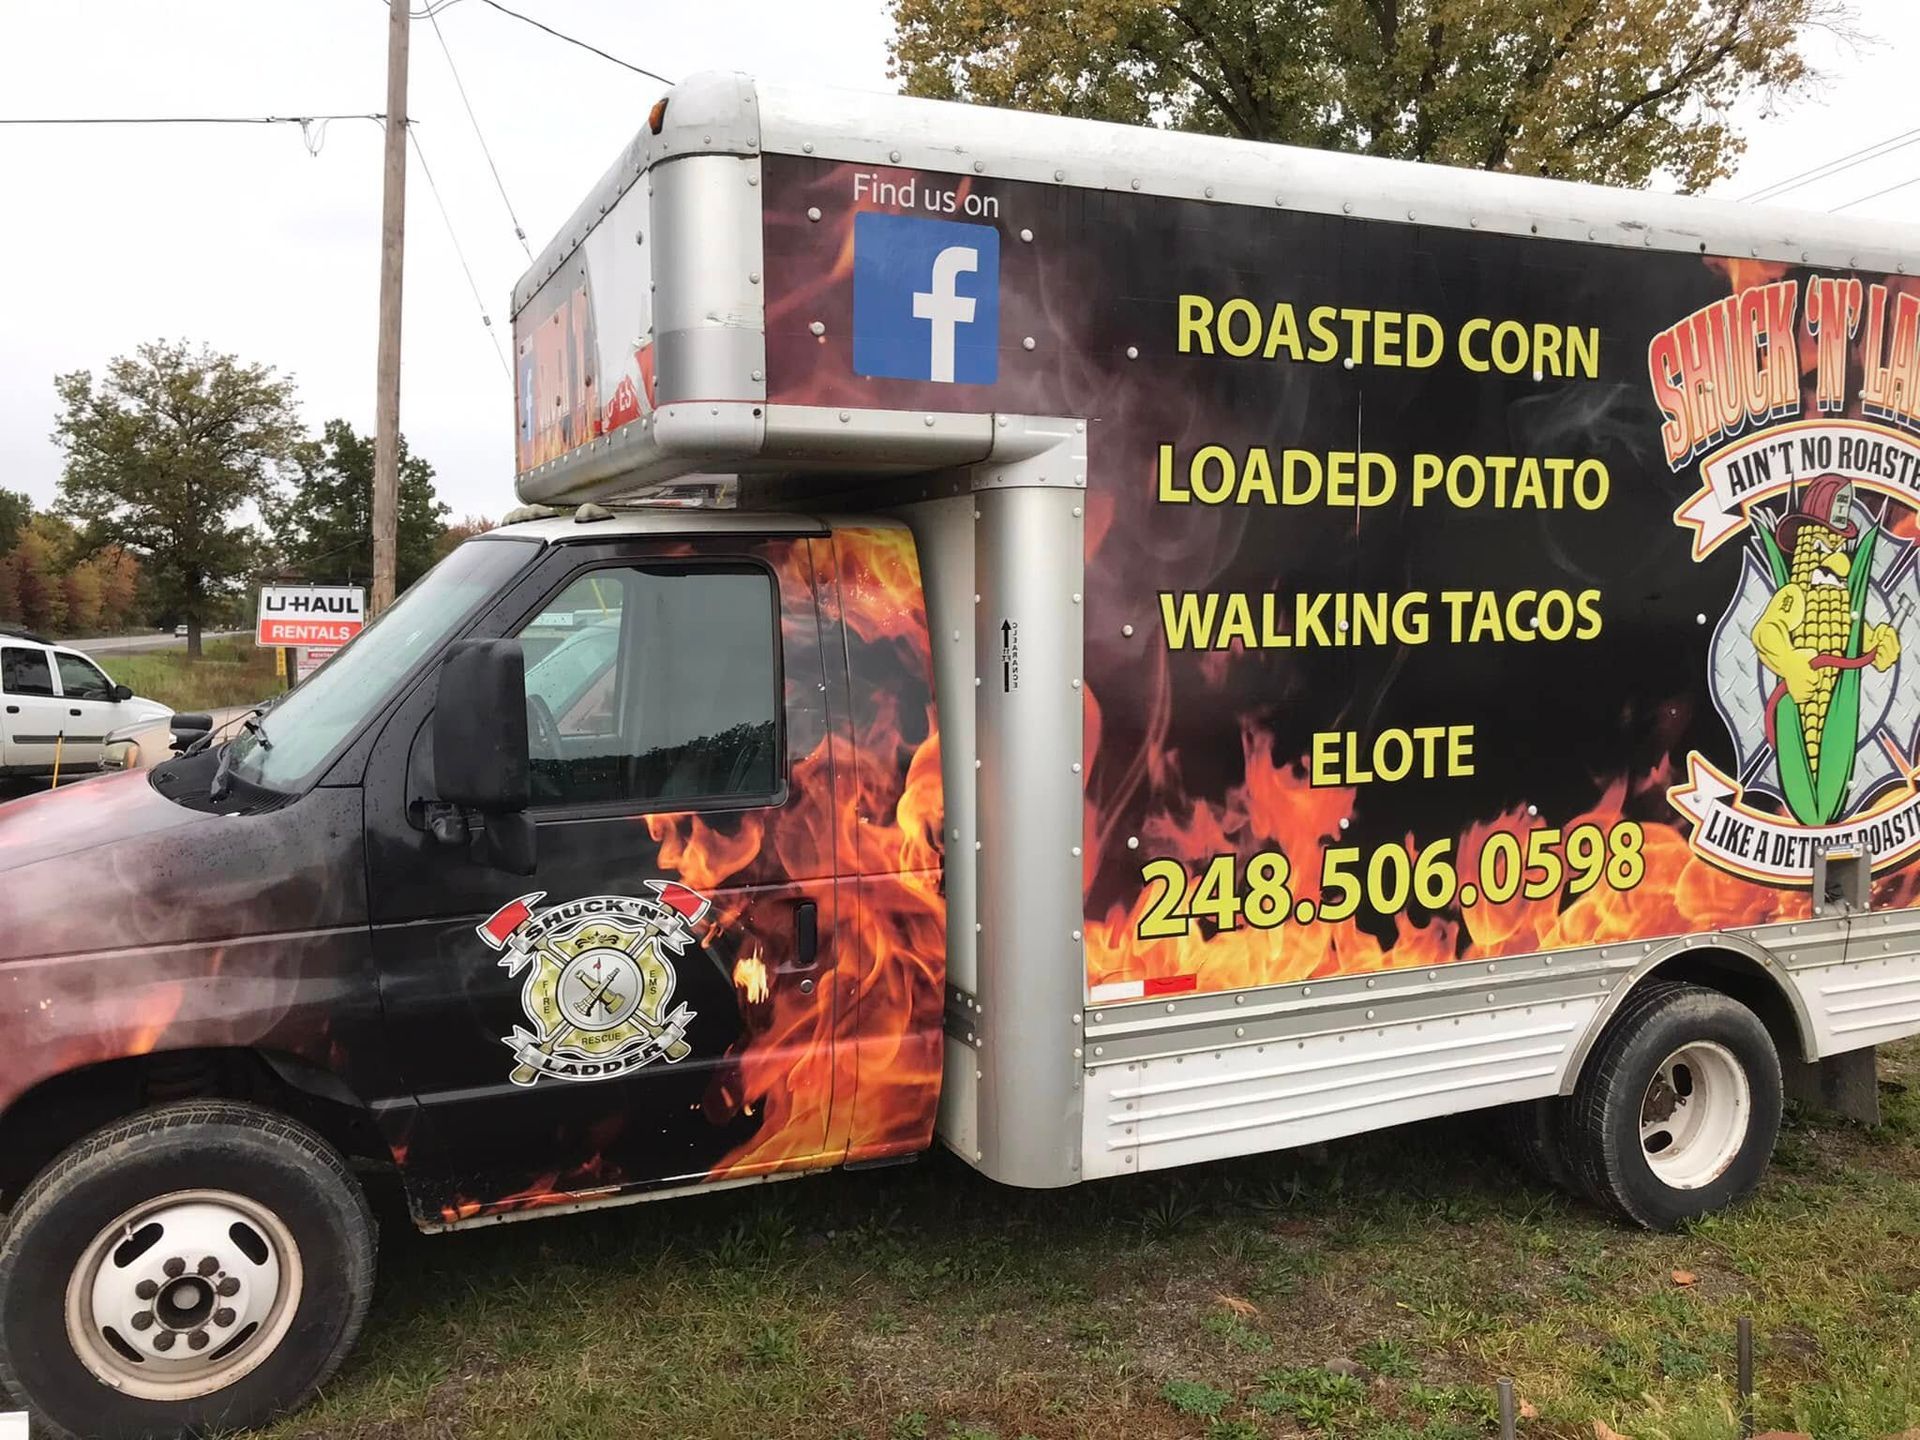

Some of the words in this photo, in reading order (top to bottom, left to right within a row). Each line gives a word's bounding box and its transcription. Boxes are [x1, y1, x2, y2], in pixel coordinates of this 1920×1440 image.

[853, 172, 915, 208] Find
[924, 188, 956, 213] us
[964, 194, 999, 218] on
[1177, 294, 1444, 368] ROASTED
[1457, 318, 1600, 379] CORN
[1649, 280, 1800, 472] SHUCK
[1862, 284, 1920, 433] LA
[1158, 444, 1397, 507] LOADED
[1412, 454, 1610, 510] POTATO
[1727, 440, 1795, 497] AIN'T
[1800, 436, 1832, 472] NO
[266, 596, 358, 613] U-HAUL
[1160, 591, 1430, 650] WALKING
[1441, 589, 1603, 644] TACOS
[272, 626, 350, 639] RENTALS
[1311, 724, 1476, 787] ELOTE
[1705, 809, 1755, 858] LIKE
[1752, 830, 1769, 864] A
[1137, 820, 1646, 939] 248.506.0598
[525, 899, 625, 941] SHUCK
[542, 980, 551, 1014] FIRE
[649, 970, 658, 995] EMS
[541, 1042, 663, 1076] LADDER
[581, 1032, 622, 1046] RESCUE
